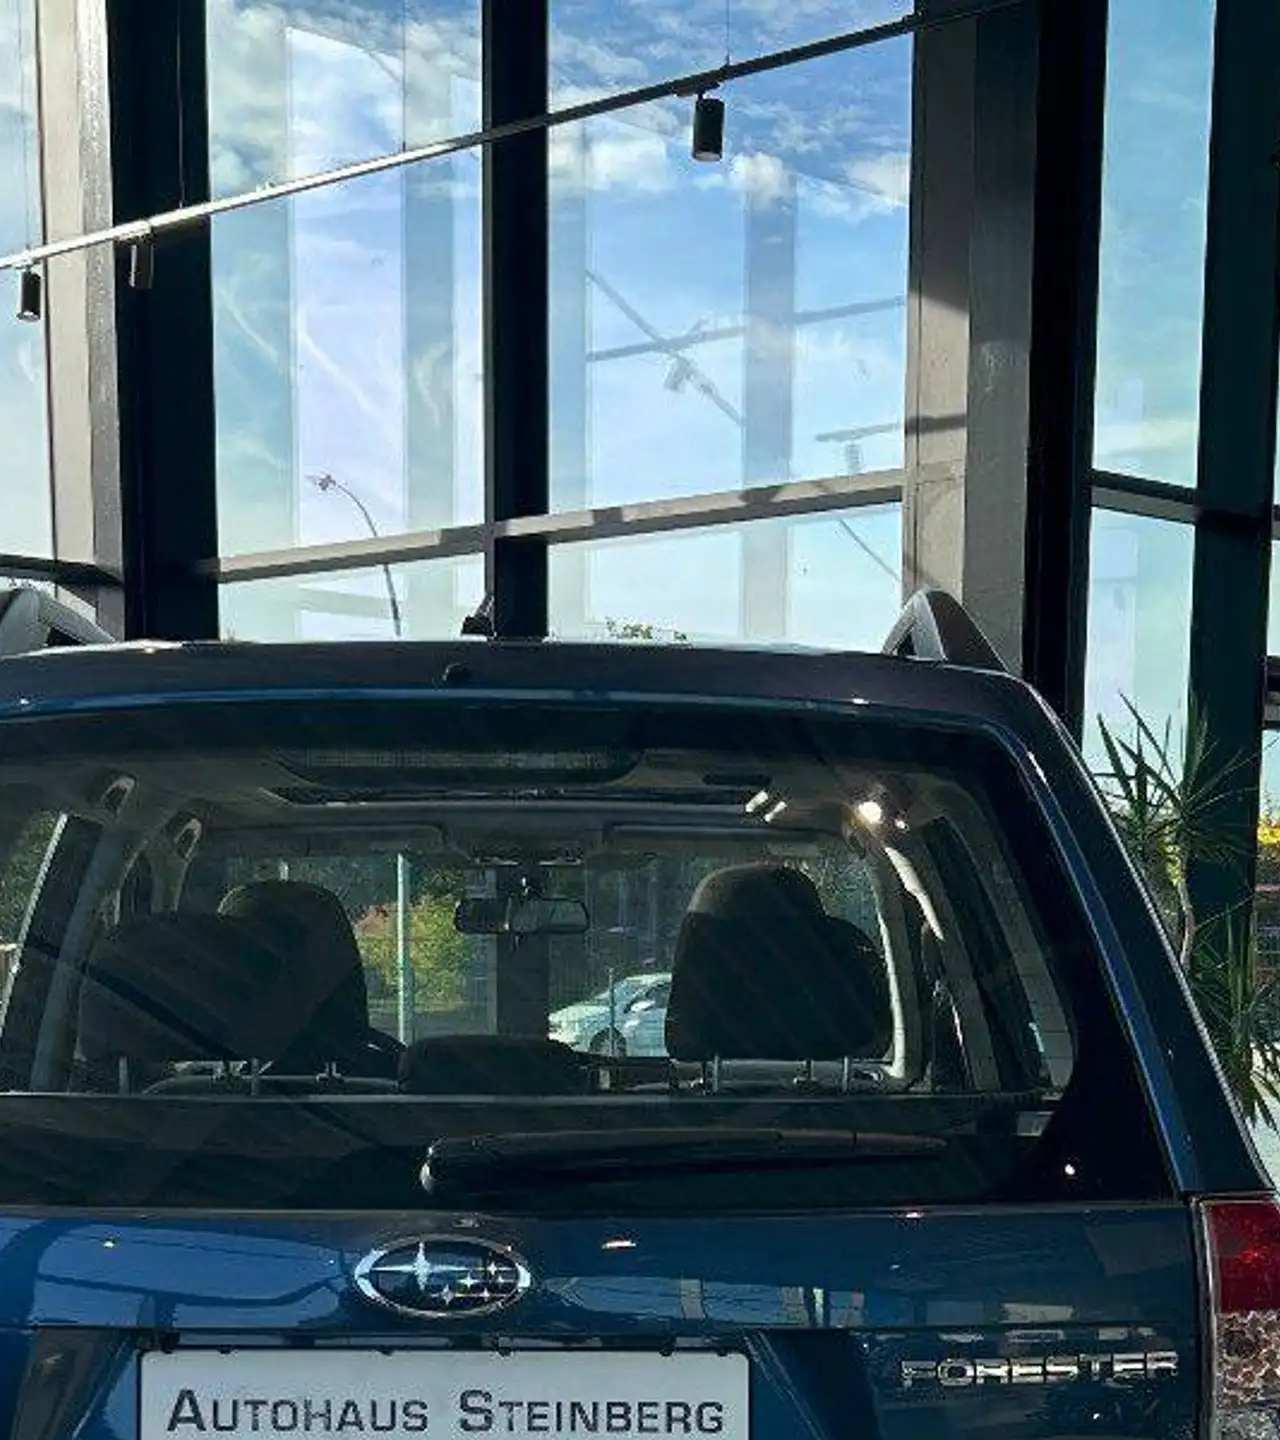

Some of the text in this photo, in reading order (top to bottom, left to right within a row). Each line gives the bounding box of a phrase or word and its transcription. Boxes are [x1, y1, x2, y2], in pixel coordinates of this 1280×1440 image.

[901, 1351, 1179, 1386] FORESTER
[167, 1389, 724, 1433] AUTOHAUS STEINBERG
